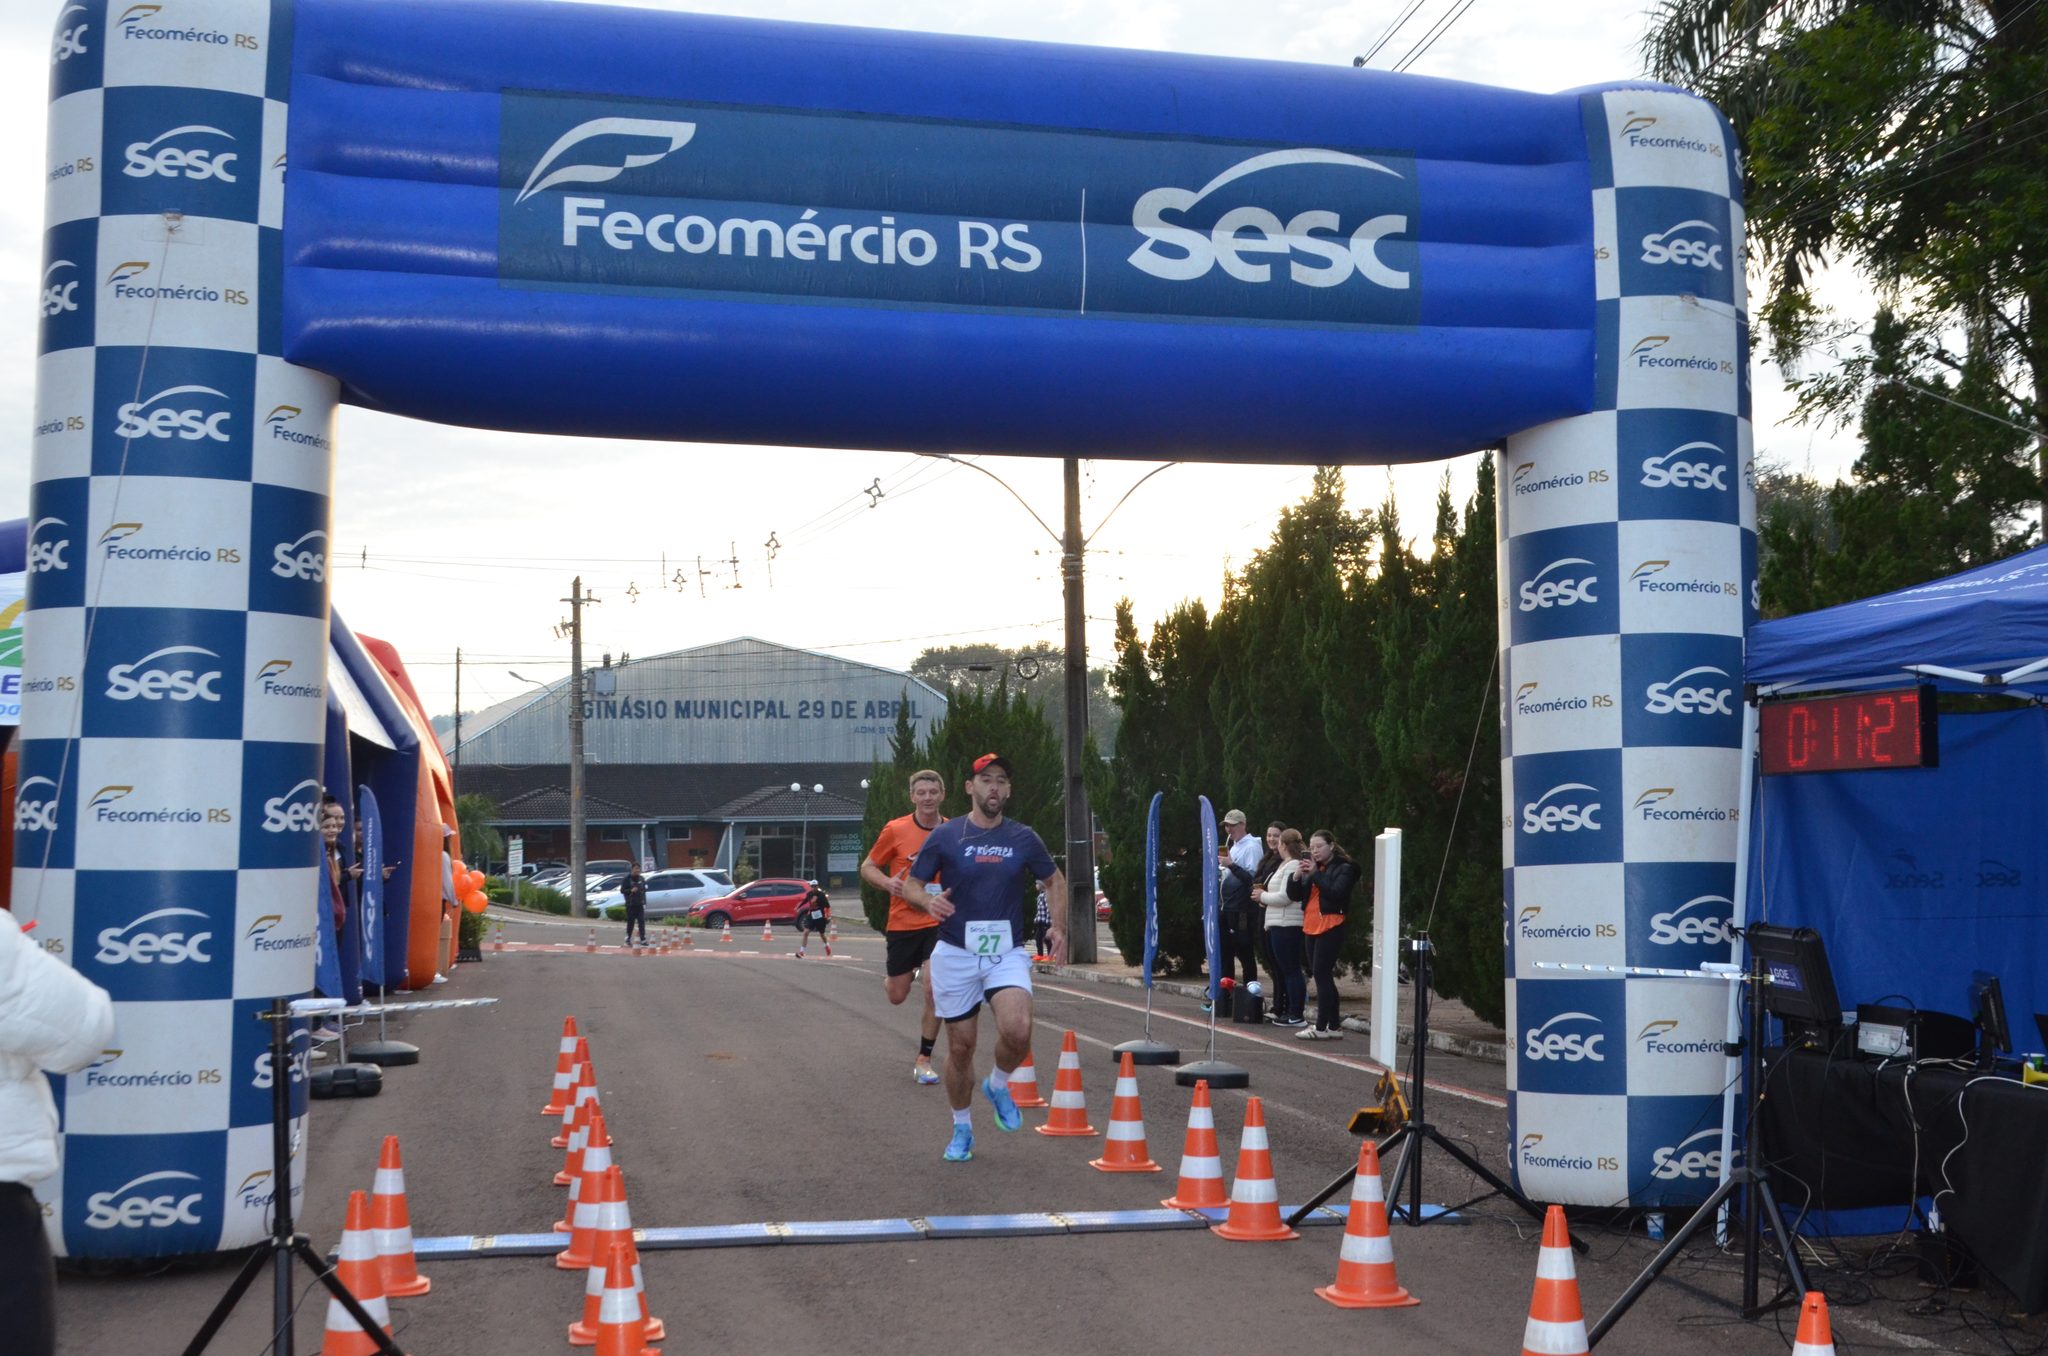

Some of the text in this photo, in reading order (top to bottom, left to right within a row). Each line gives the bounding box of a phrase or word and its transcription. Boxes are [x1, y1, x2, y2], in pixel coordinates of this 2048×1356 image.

[125, 26, 259, 50] Fecomércio RS
[1629, 134, 1723, 158] Fecomércio RS
[77, 157, 94, 172] RS
[123, 142, 237, 183] Sesc
[562, 196, 1043, 273] Fecomércio RS
[1127, 187, 1410, 290] Sesc
[1640, 233, 1723, 271] Sesc
[42, 280, 78, 318] esc
[115, 284, 249, 306] Fecomércio RS
[1638, 354, 1734, 375] Fecomércio RS
[67, 416, 85, 432] RS
[115, 402, 231, 443] Sesc
[1515, 470, 1610, 497] Fecomércio RS
[1640, 456, 1727, 492] Sesc
[30, 539, 69, 573] esc
[106, 544, 241, 564] Fecomércio RS
[271, 542, 325, 583] Ses
[1519, 576, 1598, 613] Sesc
[1639, 579, 1721, 595] Fecomércio
[1723, 582, 1738, 597] RS
[56, 676, 76, 692] RS
[105, 663, 222, 702] Sesc
[582, 697, 668, 720] GINÁSIO
[674, 699, 791, 720] MUNICIPAL
[798, 699, 826, 720] 29
[831, 700, 857, 720] DE
[1519, 696, 1588, 716] Fecomércio
[1592, 694, 1613, 709] RS
[1644, 682, 1733, 716] Sesc
[1788, 693, 1921, 769] 0:11:27
[15, 799, 58, 831] esc
[97, 807, 232, 824] Fecomércio RS
[1522, 802, 1602, 835] Sesc
[1643, 806, 1726, 822] Fecomércio
[1521, 922, 1618, 940] Fecomércio RS
[47, 938, 65, 953] RS
[95, 927, 213, 965] Sesc
[978, 934, 1001, 954] 27
[1525, 1027, 1605, 1063] Sesc
[1646, 1038, 1725, 1055] Fecomérci
[87, 1068, 222, 1087] Fecomércio RS
[1523, 1151, 1620, 1171] Fecomércio RS
[84, 1191, 203, 1230] Sesc
